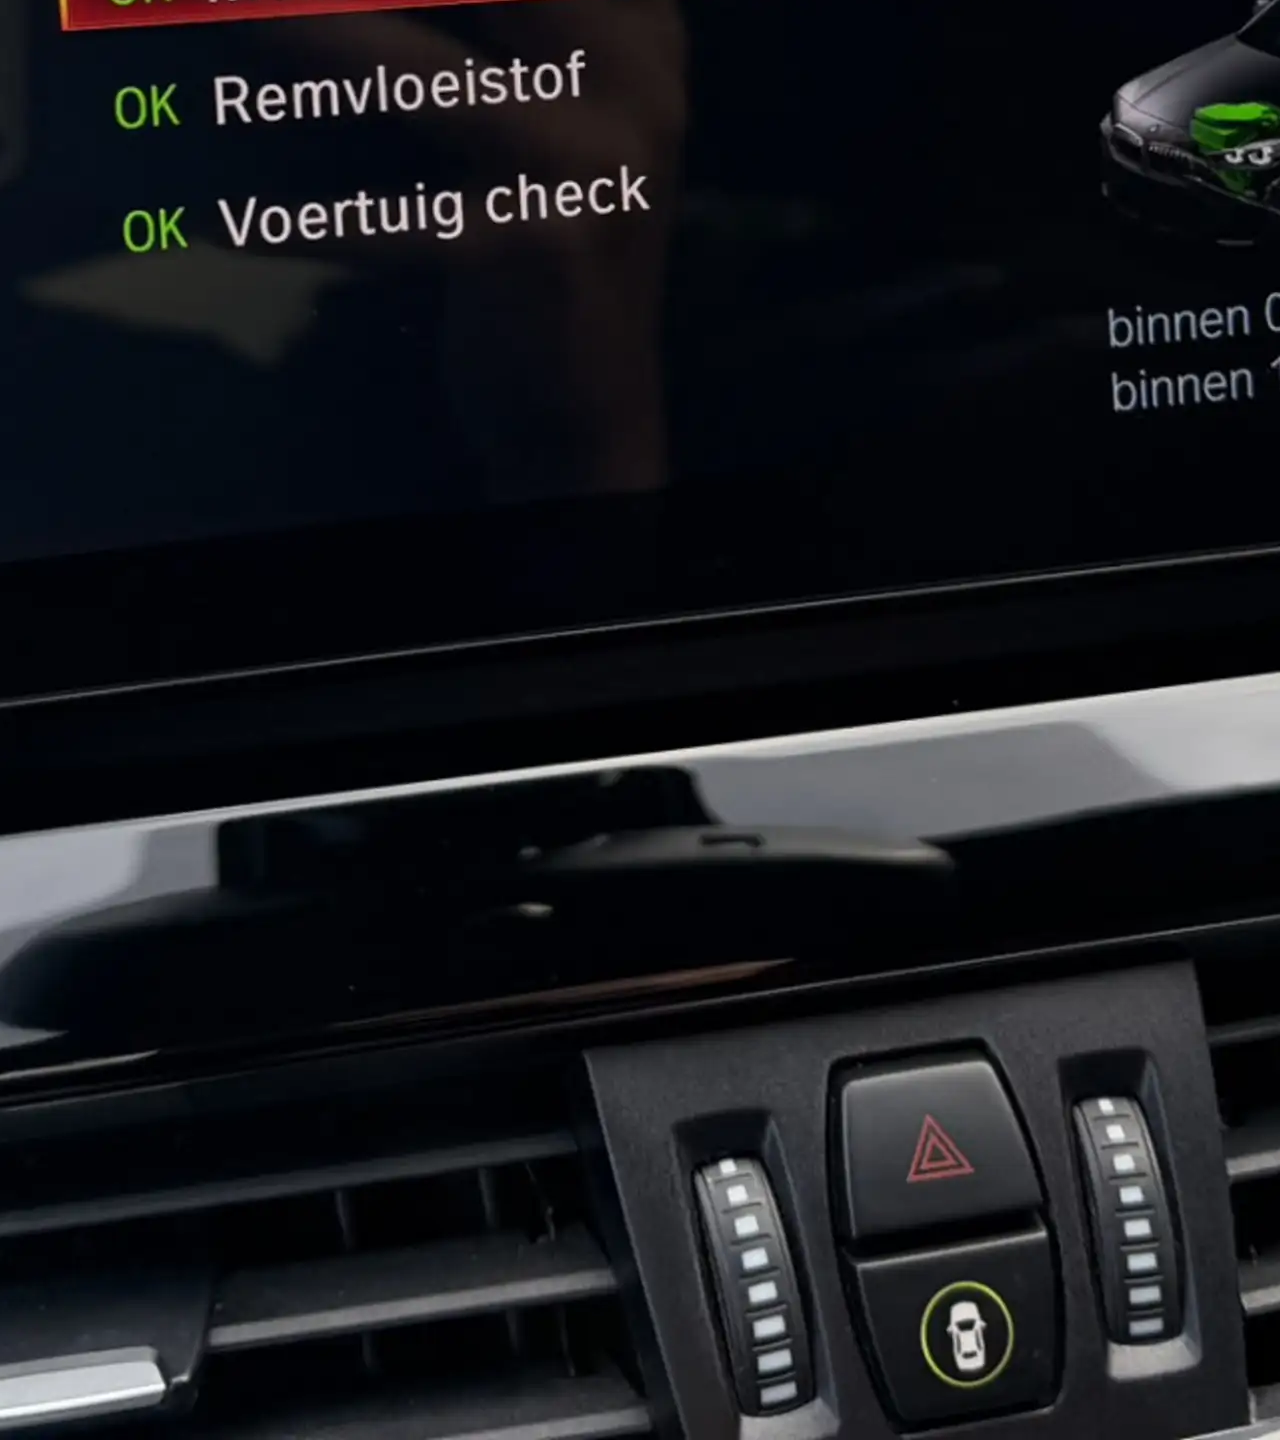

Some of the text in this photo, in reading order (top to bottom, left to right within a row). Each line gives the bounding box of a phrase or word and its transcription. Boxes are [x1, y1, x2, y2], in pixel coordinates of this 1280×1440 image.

[115, 50, 586, 129] OK Remvloeistof
[123, 165, 650, 253] OK Voertuig check
[1108, 305, 1250, 348] binnen
[1111, 368, 1253, 411] binnen
